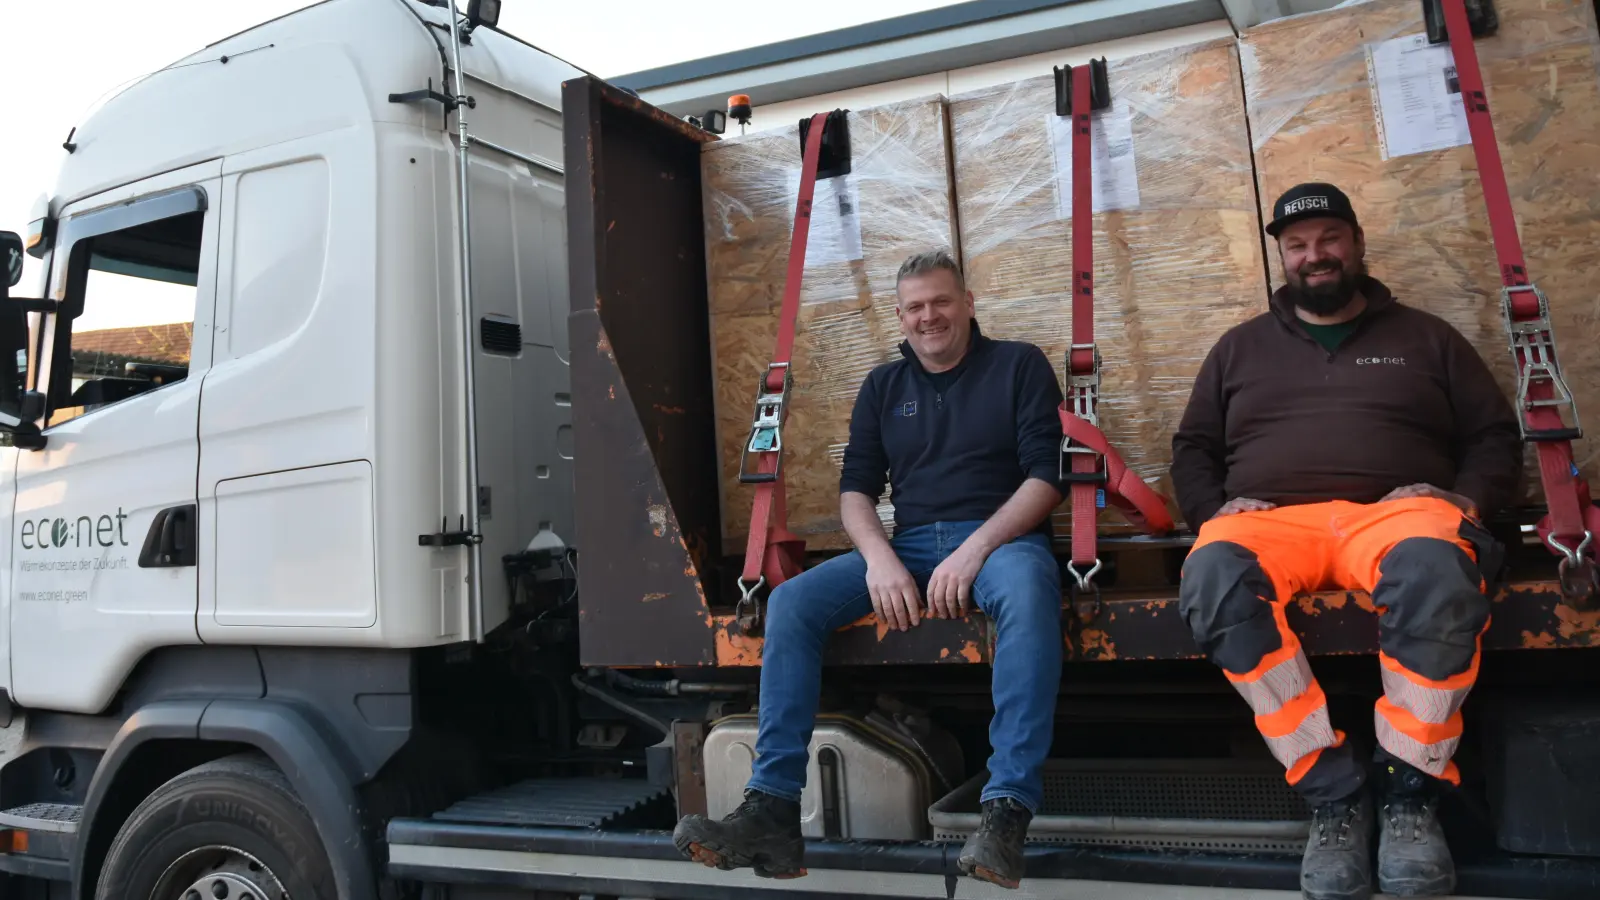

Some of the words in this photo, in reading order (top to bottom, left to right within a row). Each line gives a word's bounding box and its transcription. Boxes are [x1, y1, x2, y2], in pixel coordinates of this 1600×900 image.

[1284, 198, 1328, 216] REUSCH
[79, 557, 92, 571] der
[20, 590, 87, 603] www.econet.green
